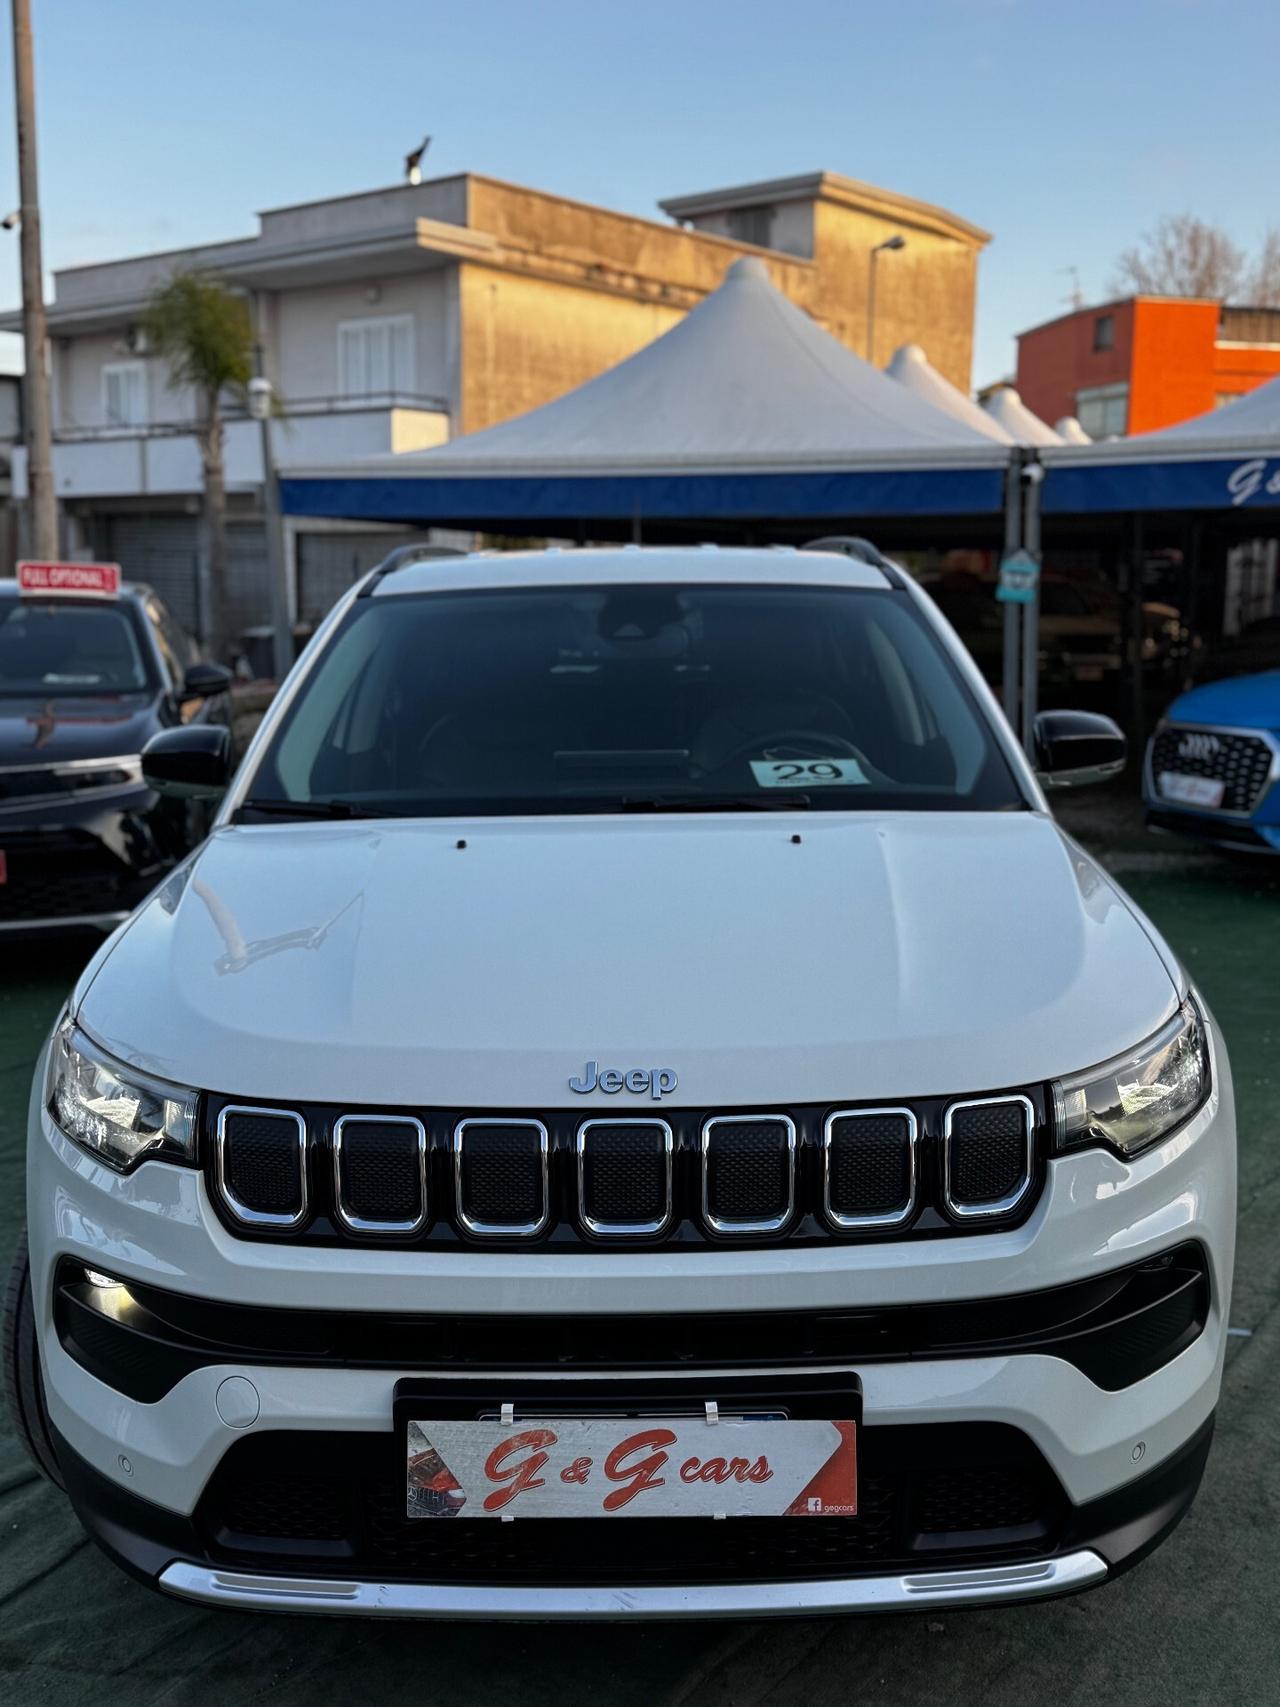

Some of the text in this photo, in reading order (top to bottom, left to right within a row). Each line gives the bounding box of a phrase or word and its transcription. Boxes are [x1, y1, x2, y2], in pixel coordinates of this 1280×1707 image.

[1227, 459, 1267, 506] G
[773, 763, 843, 779] 29
[569, 1061, 678, 1100] Jeep
[483, 1429, 774, 1512] G & G cars
